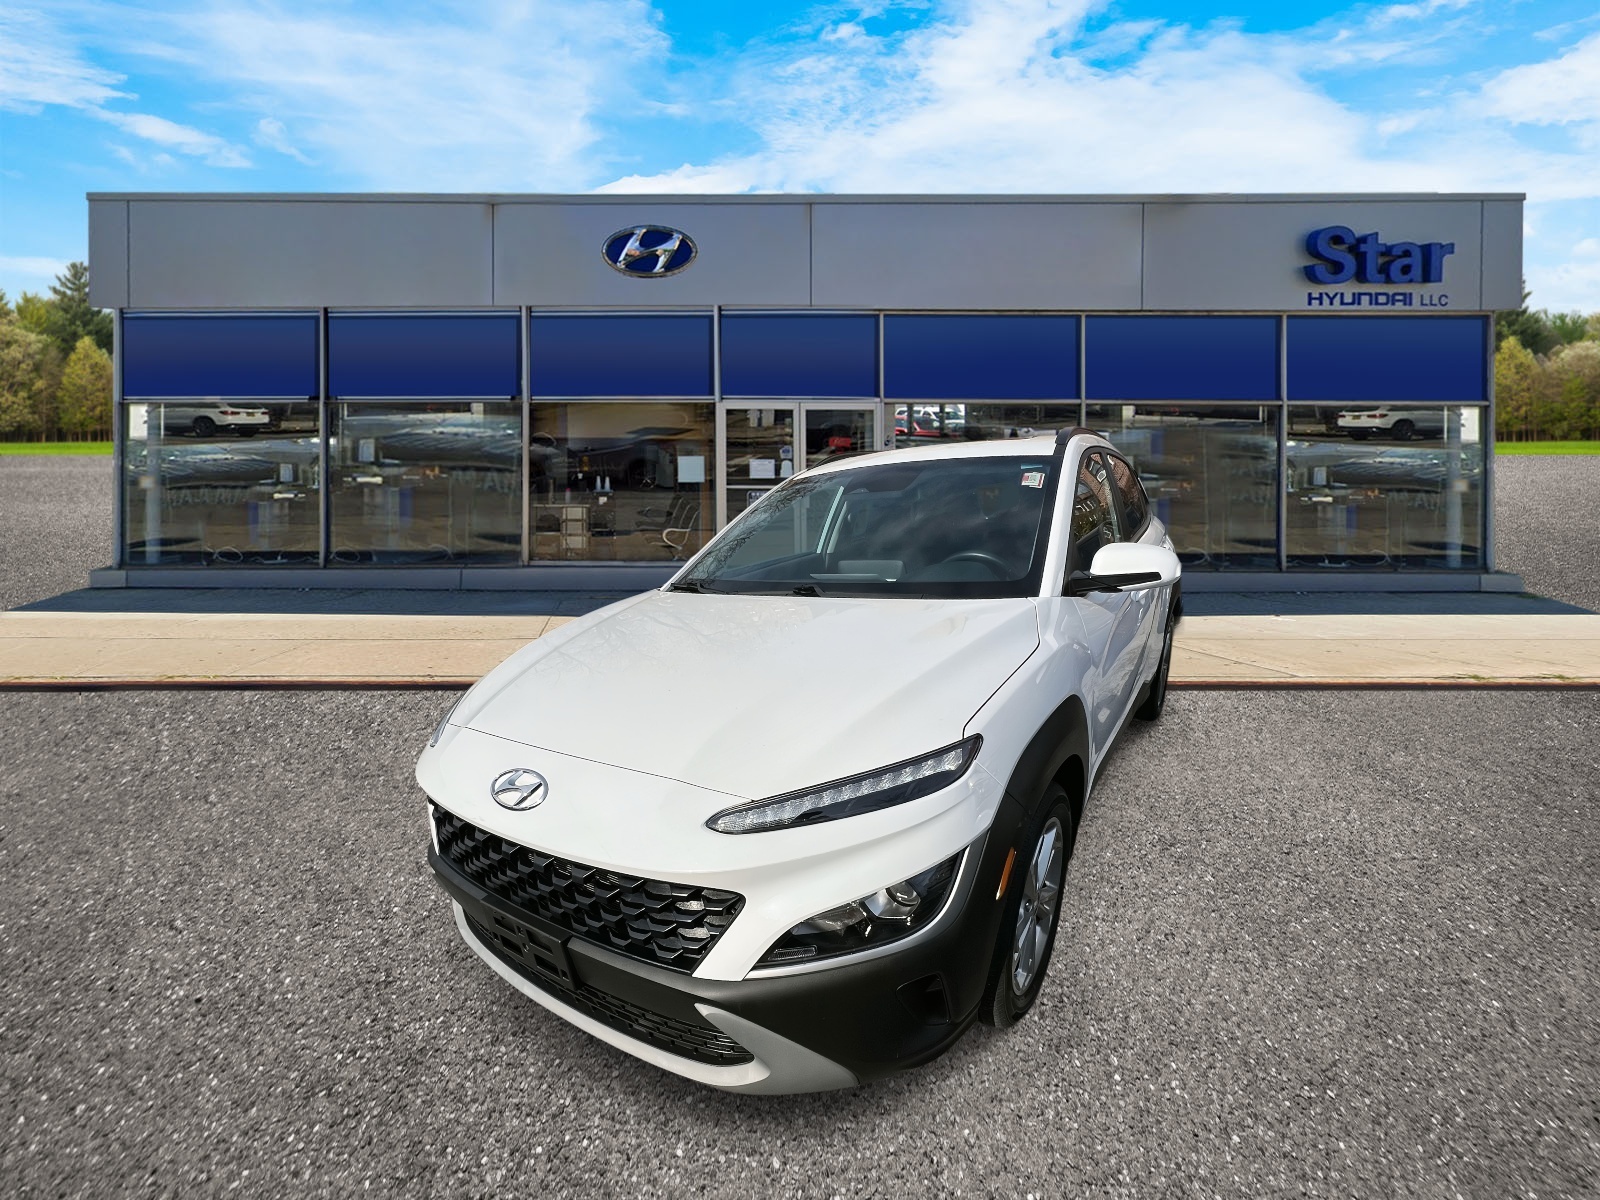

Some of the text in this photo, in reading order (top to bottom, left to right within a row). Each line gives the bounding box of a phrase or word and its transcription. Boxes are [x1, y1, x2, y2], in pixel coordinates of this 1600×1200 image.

[1303, 225, 1455, 285] Star
[1307, 292, 1449, 307] HYUNDAI LLC
